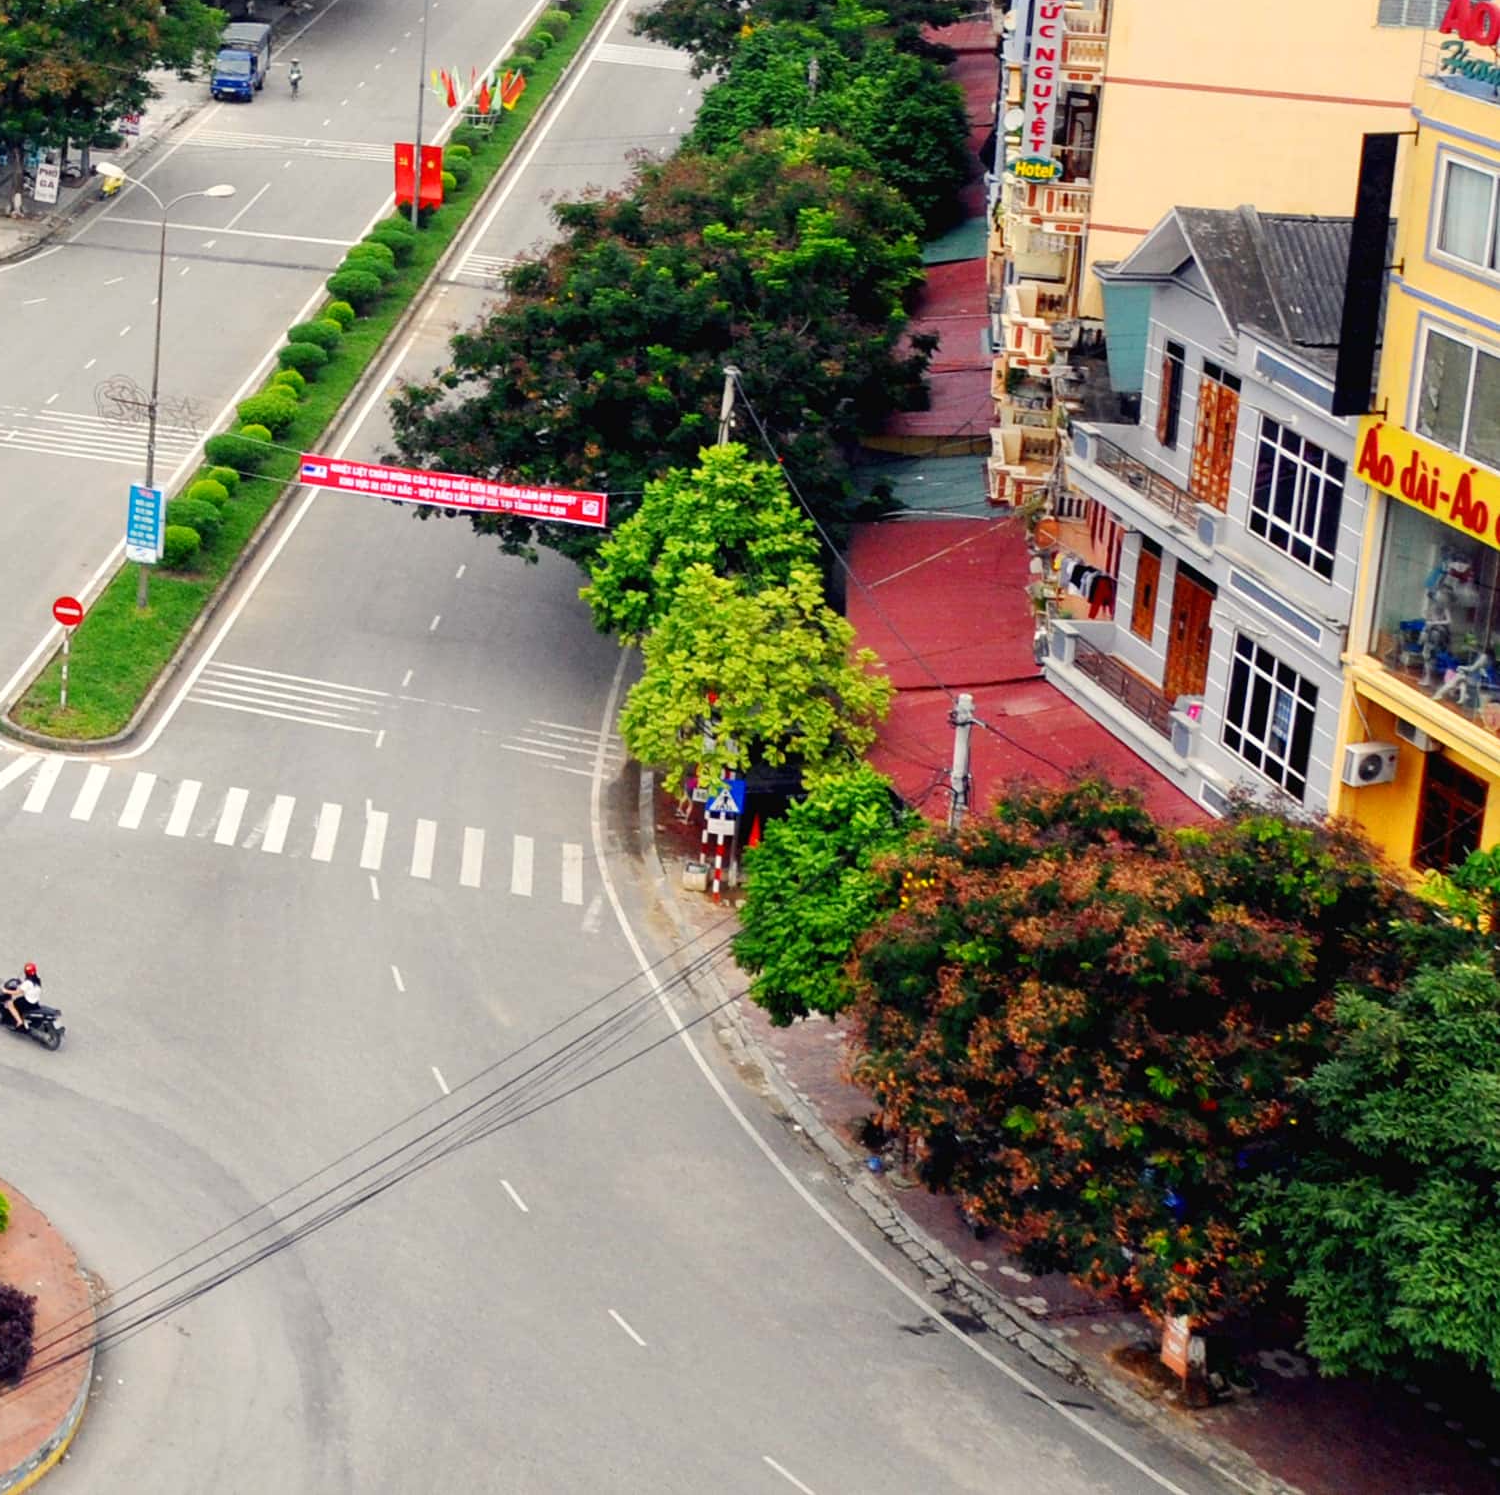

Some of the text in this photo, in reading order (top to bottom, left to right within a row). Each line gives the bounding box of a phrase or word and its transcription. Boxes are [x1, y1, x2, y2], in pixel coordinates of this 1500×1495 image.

[1030, 47, 1056, 153] NGUYỆT
[1015, 161, 1054, 179] Hotel
[1358, 422, 1395, 487] Áo
